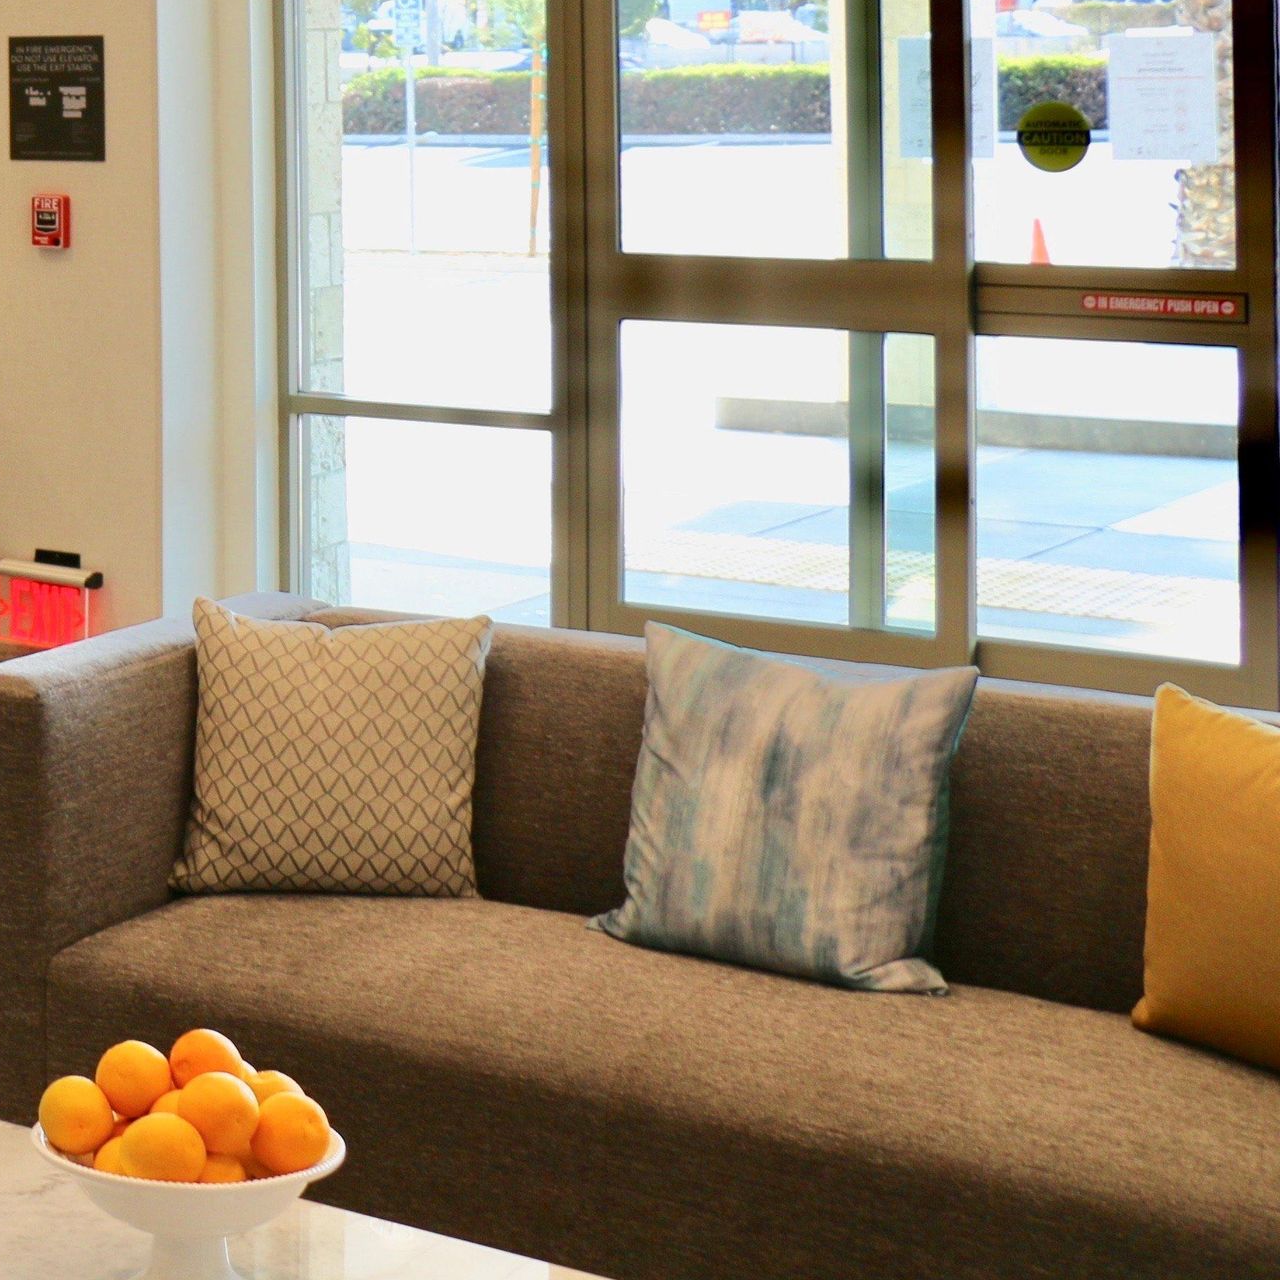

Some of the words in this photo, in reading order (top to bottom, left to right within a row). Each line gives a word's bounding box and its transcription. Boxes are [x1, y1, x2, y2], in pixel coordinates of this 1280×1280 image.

[15, 46, 24, 54] IN
[26, 46, 42, 54] FIRE
[11, 55, 23, 63] DO
[25, 55, 41, 63] NOT
[42, 55, 57, 63] USE
[16, 64, 31, 72] USE
[33, 64, 47, 72] THE
[49, 64, 65, 72] EXIT
[1025, 120, 1080, 129] AUTOMATIC
[1022, 133, 1086, 144] CAUTION
[34, 198, 59, 209] FIRE
[1097, 296, 1108, 309] IN
[1109, 296, 1165, 312] EMERGENCY
[1167, 299, 1192, 313] PUSH
[1194, 300, 1219, 314] OPEN
[10, 577, 78, 642] EXIT
